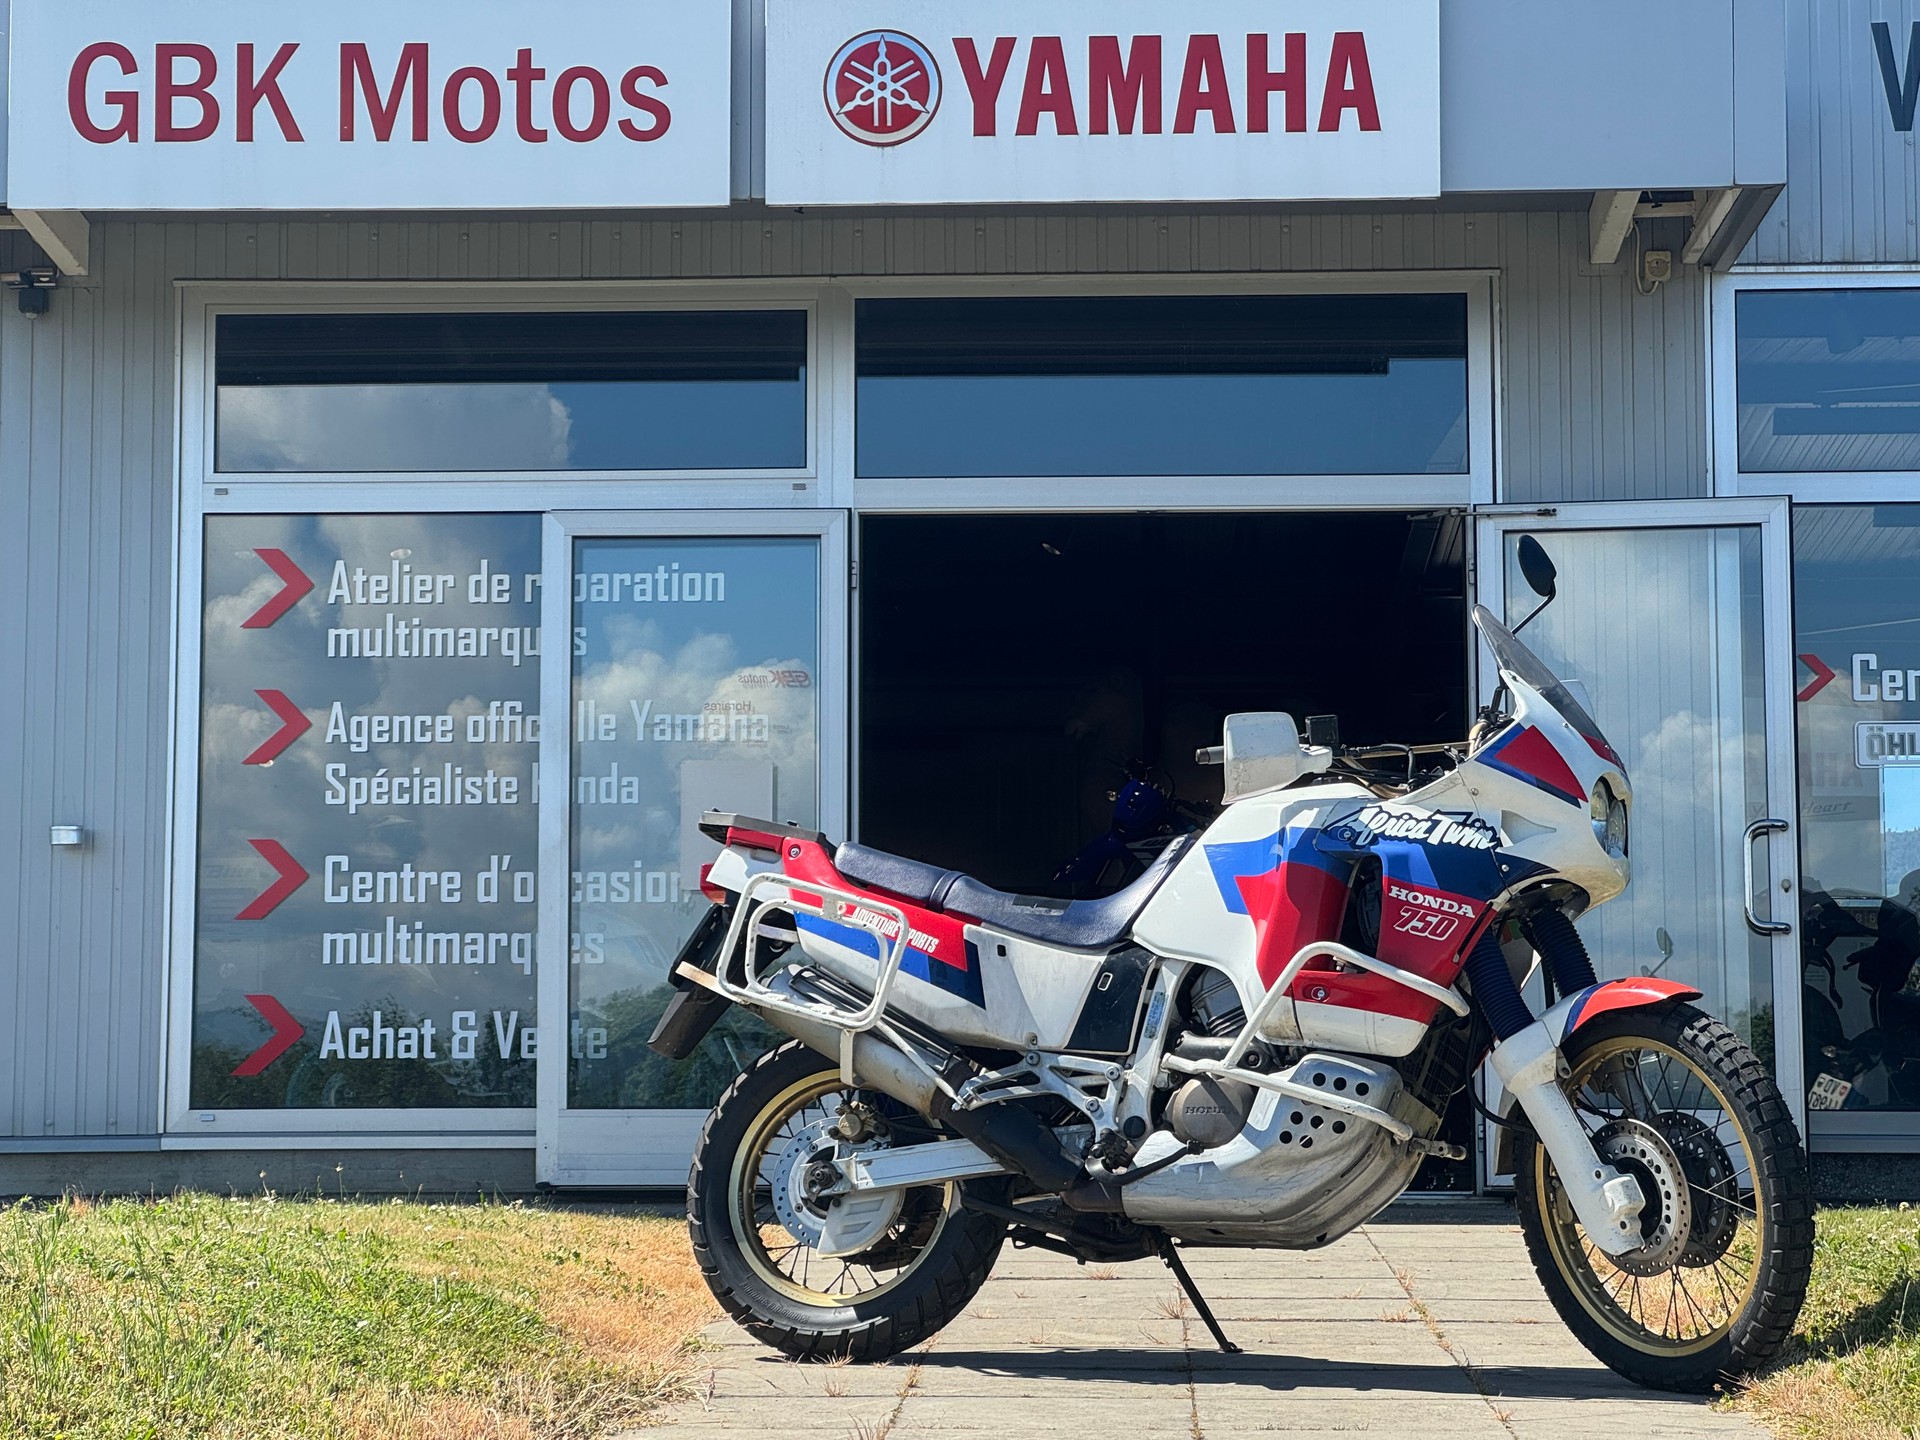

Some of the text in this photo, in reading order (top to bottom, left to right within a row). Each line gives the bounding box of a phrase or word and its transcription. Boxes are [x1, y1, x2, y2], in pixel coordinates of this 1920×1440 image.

[67, 41, 673, 144] GBK Motos
[951, 31, 1382, 137] YAMAHA
[327, 558, 726, 605] Atelier de rparation
[326, 613, 587, 666] multimarqus
[325, 699, 769, 752] Agence officlle Yamaha
[324, 762, 639, 813] Spécialiste nda
[323, 855, 461, 904] Centre
[1388, 885, 1476, 919] HONDA
[321, 915, 605, 976] multimarqes
[851, 907, 940, 954] ADVENTURE PORTS
[1393, 905, 1459, 942] 750
[319, 1010, 607, 1060] Achat & Vete
